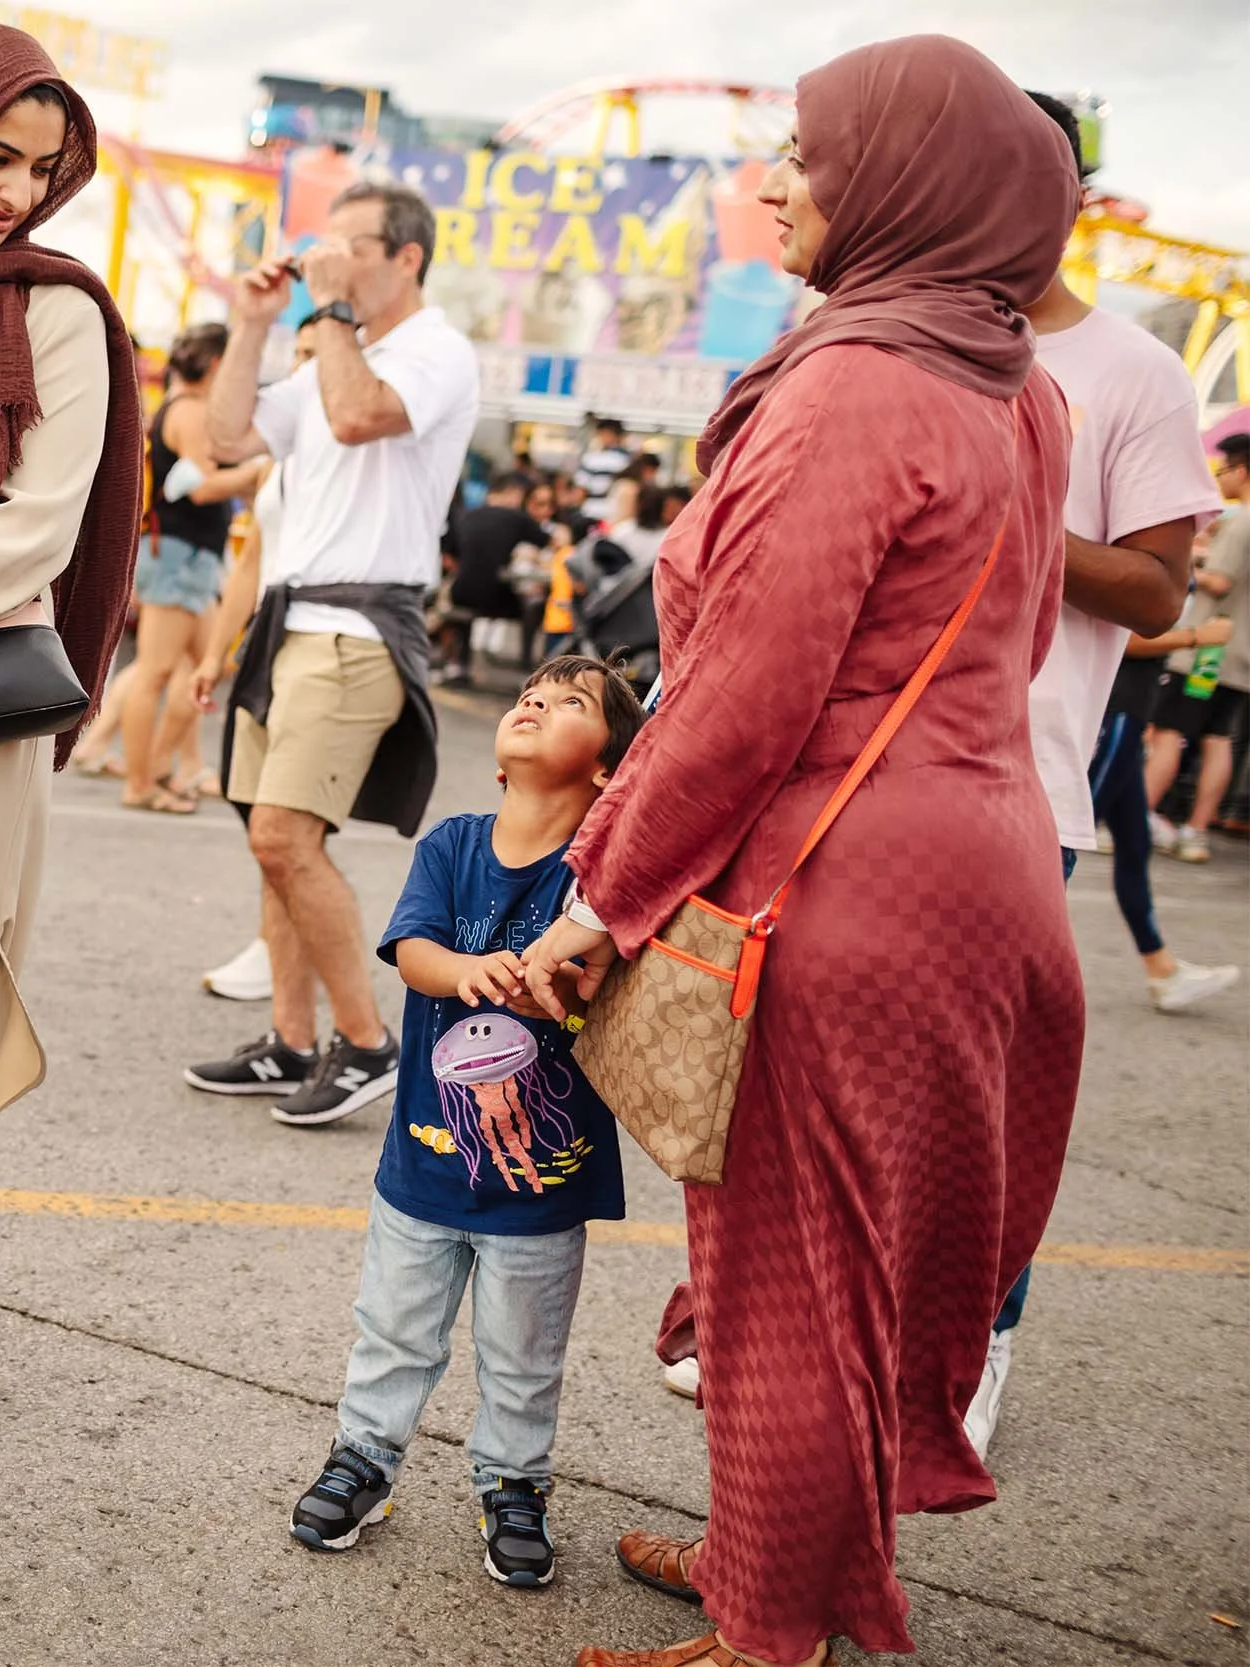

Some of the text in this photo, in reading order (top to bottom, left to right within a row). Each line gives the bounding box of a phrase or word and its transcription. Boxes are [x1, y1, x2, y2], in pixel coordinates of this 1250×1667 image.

[460, 149, 603, 213] ICE
[435, 207, 690, 276] REAM
[455, 916, 526, 955] NICE
